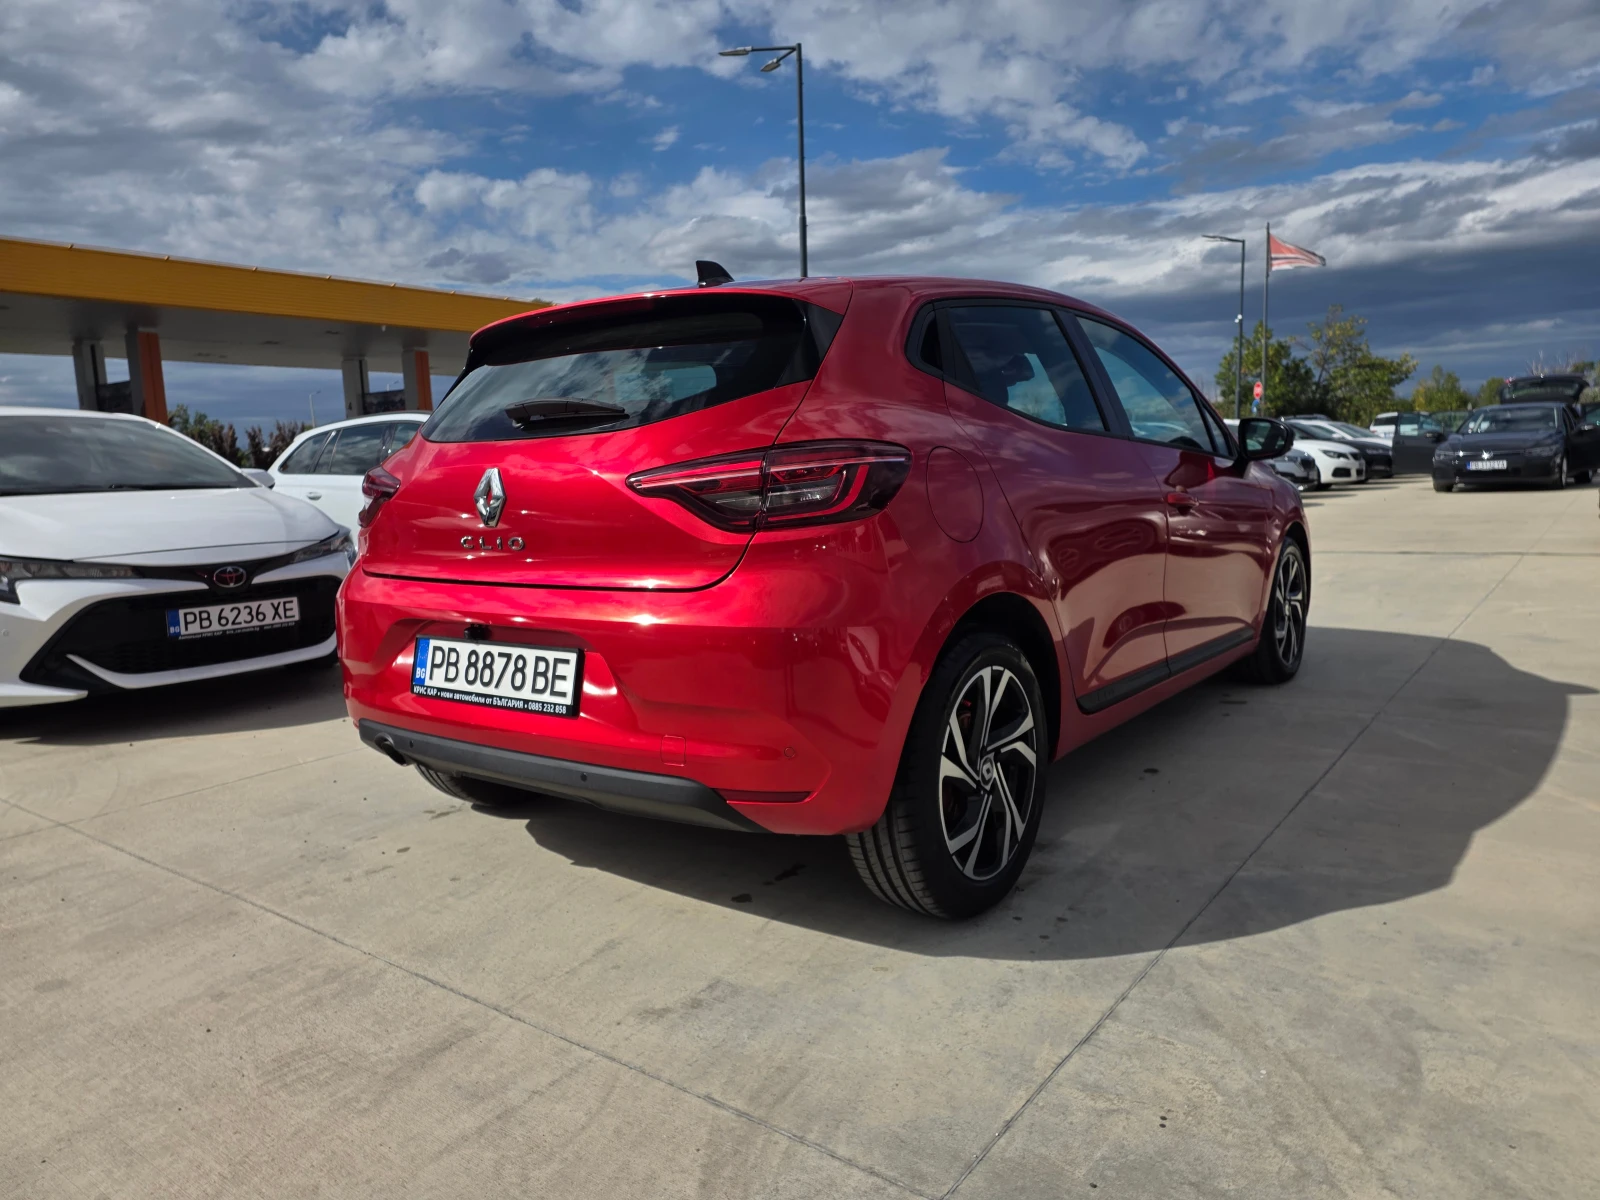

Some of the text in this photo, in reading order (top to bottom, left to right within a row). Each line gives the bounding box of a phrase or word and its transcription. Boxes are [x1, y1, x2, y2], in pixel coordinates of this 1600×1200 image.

[460, 536, 525, 550] CLIO
[183, 610, 212, 632] PB
[217, 603, 267, 628] 6236
[270, 600, 296, 621] XE
[169, 626, 180, 634] BG
[415, 667, 426, 679] BG
[429, 645, 571, 698] PB 8878 BE
[413, 685, 427, 694] КРИС
[427, 687, 438, 696] КАР
[440, 690, 454, 699] нови
[453, 692, 486, 704] автомобили
[492, 697, 524, 709] БЪЛГАРИЯ
[528, 702, 543, 711] 0885
[543, 703, 555, 713] 232
[555, 705, 567, 714] 858
